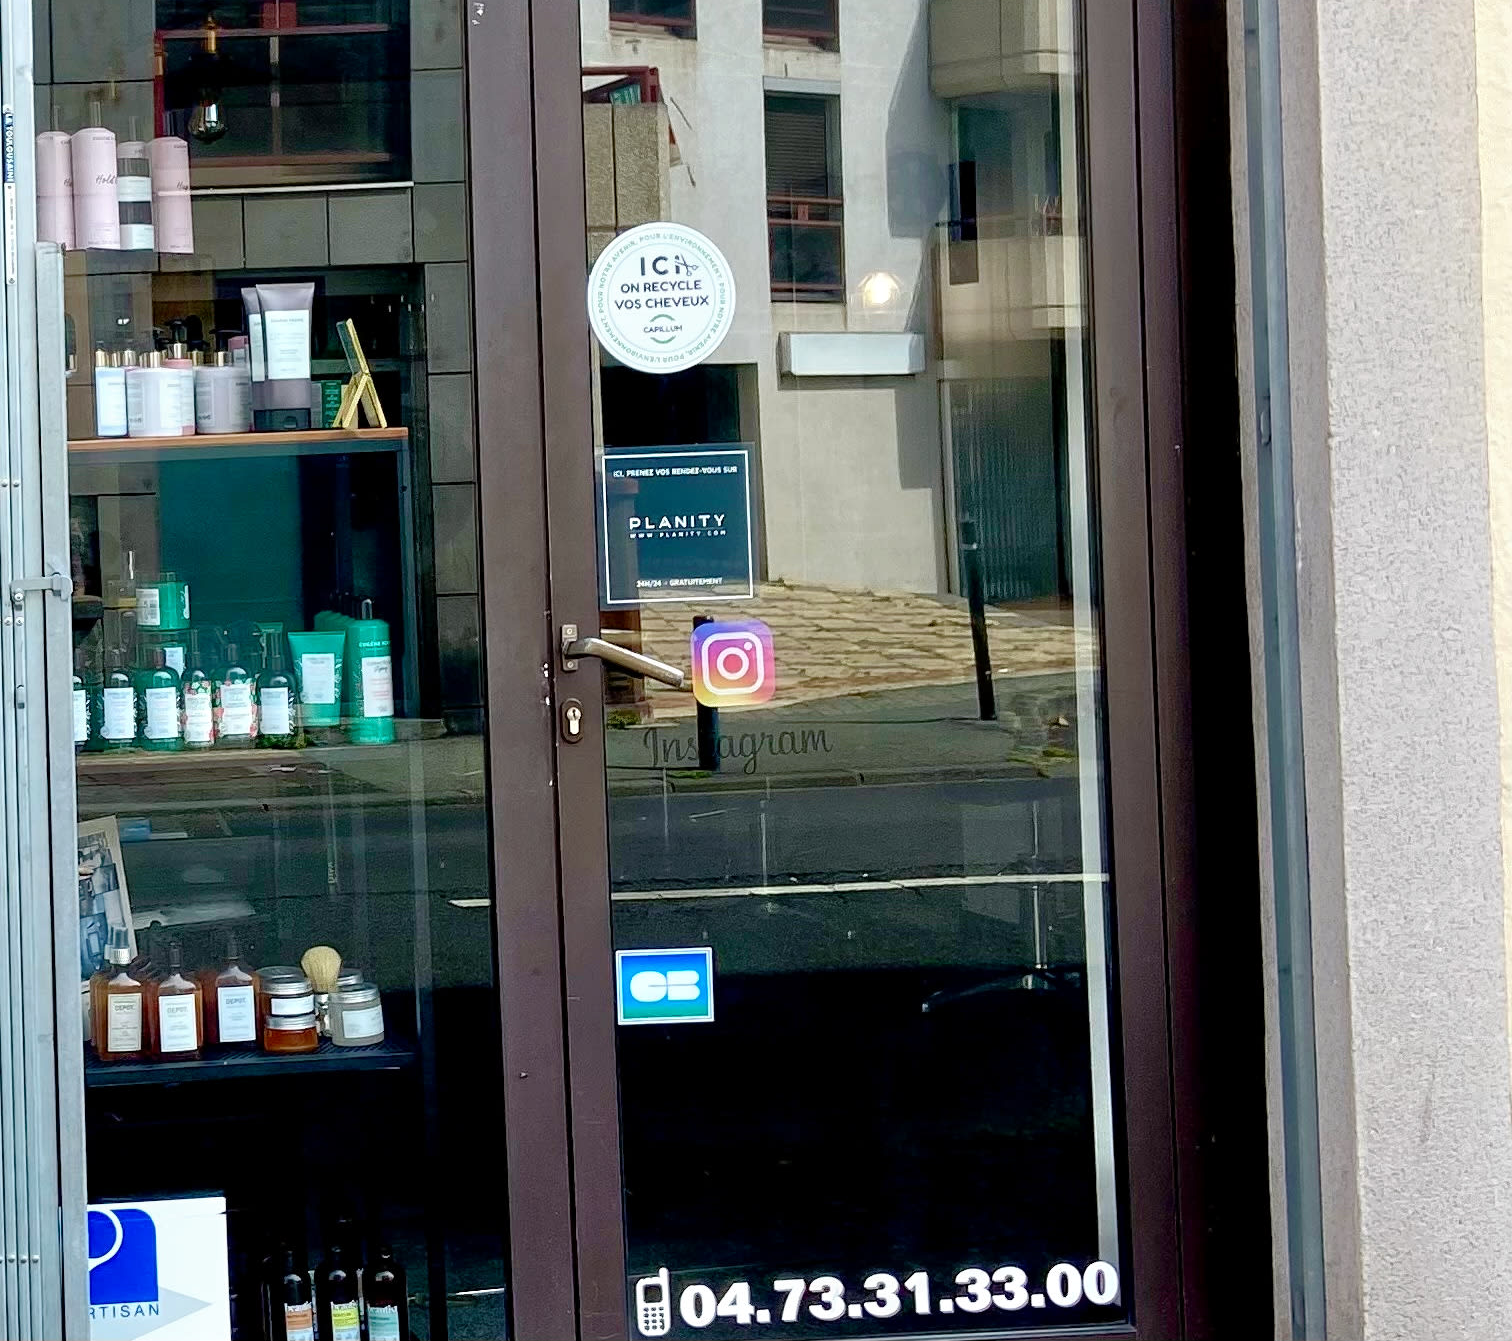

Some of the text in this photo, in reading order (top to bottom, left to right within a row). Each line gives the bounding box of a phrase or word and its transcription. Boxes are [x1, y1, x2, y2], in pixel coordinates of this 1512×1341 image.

[640, 254, 681, 276] ICI
[620, 279, 702, 294] ON RECYCLE
[614, 295, 710, 310] VOS CHEVEUX
[643, 325, 683, 334] CAPILLUM
[626, 468, 654, 477] PRENEZ
[655, 468, 670, 476] VOS
[671, 466, 722, 476] RENDEZ-VOUS
[723, 465, 738, 474] SUR
[629, 513, 725, 530] PLANITY
[669, 577, 723, 587] GRATUITEMENT
[643, 727, 834, 775] Insagram
[630, 969, 701, 1003] CB
[678, 1260, 1121, 1328] 04.73.31.33.00
[88, 1302, 159, 1319] RTISAN
